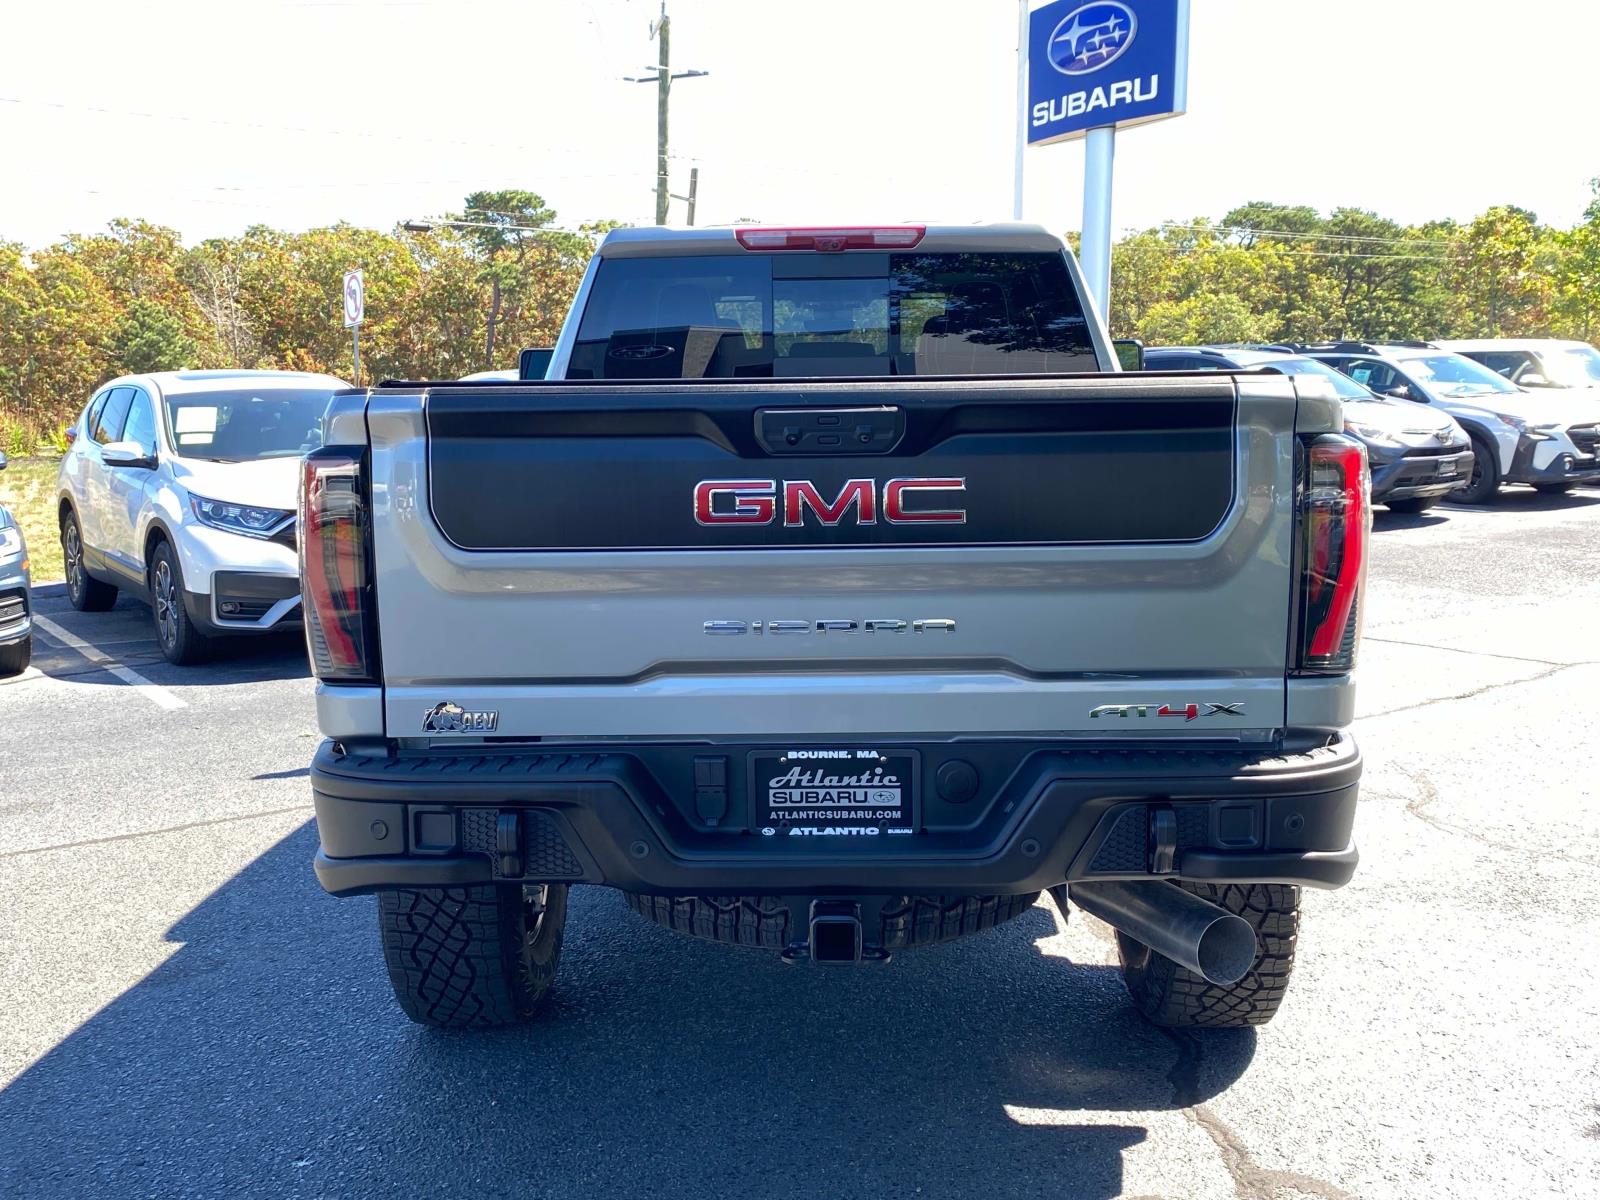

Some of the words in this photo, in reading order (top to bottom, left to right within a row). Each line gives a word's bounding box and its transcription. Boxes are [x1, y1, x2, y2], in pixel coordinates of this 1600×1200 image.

[1032, 74, 1159, 127] SUBARU
[693, 477, 967, 527] GMC
[703, 619, 956, 635] SIERRA
[1089, 702, 1245, 722] AT4X
[463, 712, 495, 730] AEV
[856, 751, 879, 759] MA
[768, 766, 901, 788] Atlantic
[772, 791, 868, 804] SUBARU
[769, 810, 902, 820] ATLANTICSUBARU.COM
[788, 827, 880, 836] ATLANTIC
